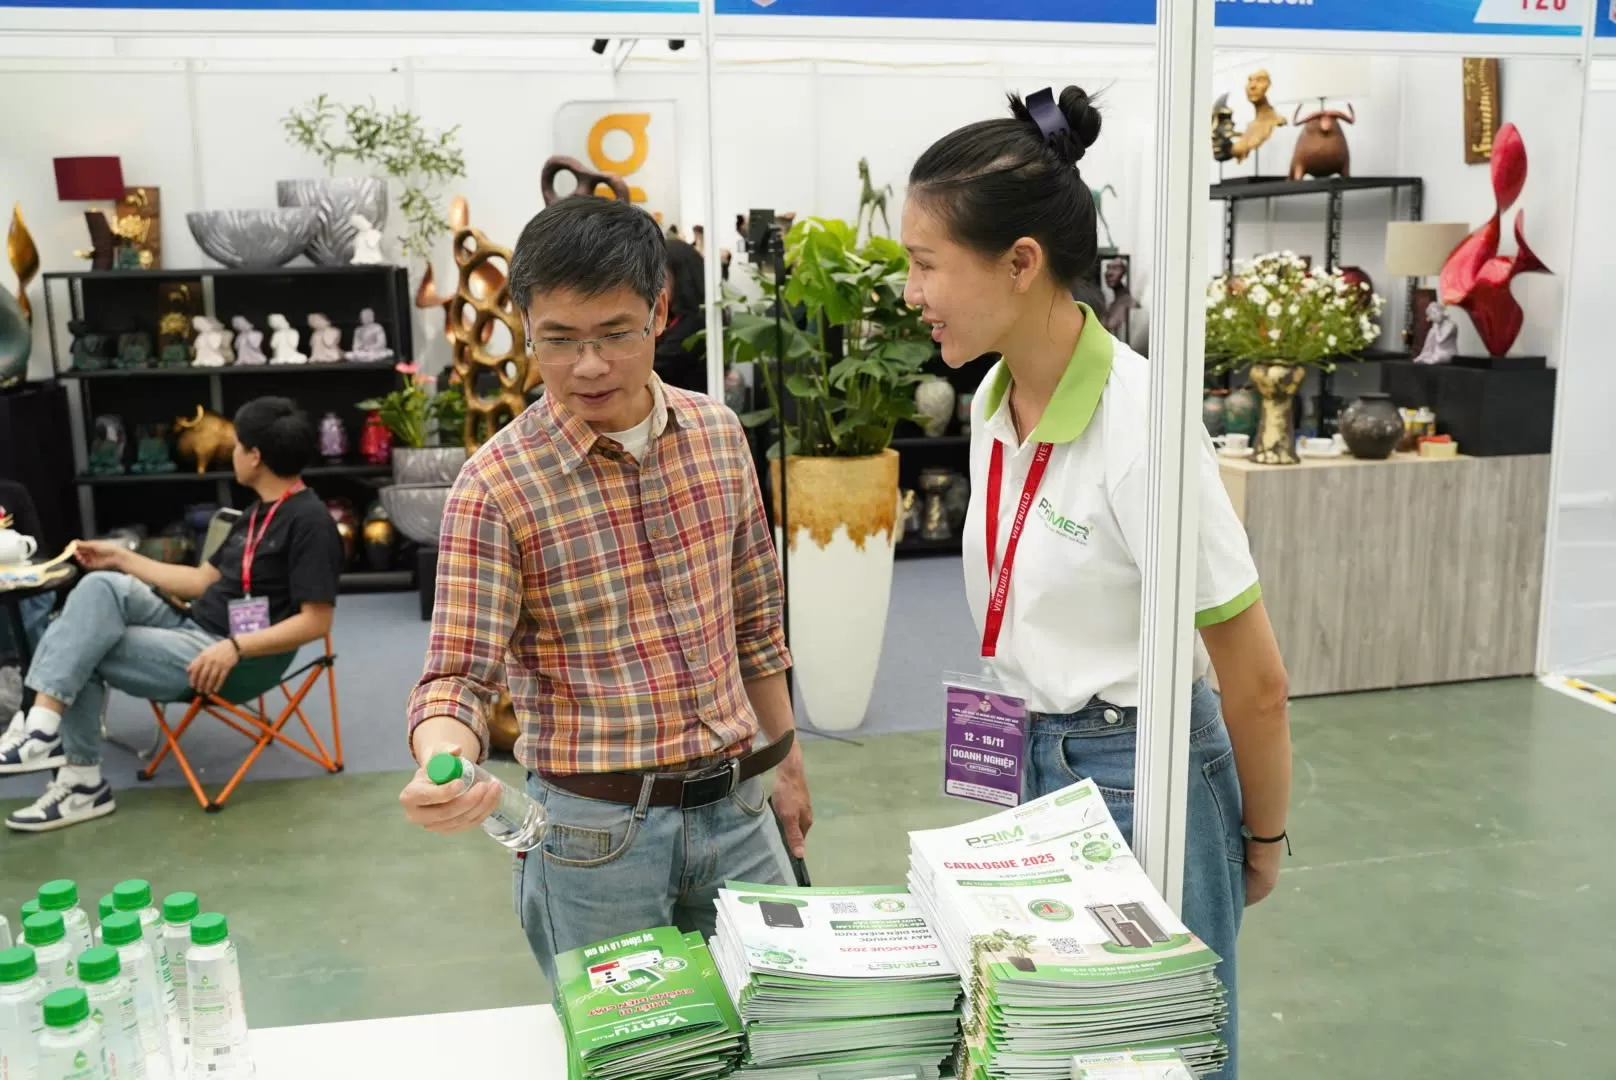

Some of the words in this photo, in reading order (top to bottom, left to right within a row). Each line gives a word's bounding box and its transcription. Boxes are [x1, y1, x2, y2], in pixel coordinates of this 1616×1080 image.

[1012, 492, 1031, 540] VIETBUILD
[993, 567, 1009, 612] VIETBUILD
[964, 732, 974, 742] 12
[982, 735, 1005, 748] 15/11
[952, 748, 981, 762] DOANH
[983, 754, 1015, 769] NGHIỆP
[943, 859, 1020, 870] CATALOGUE
[1021, 853, 1056, 867] 2025
[870, 943, 938, 952] CATALOGUE
